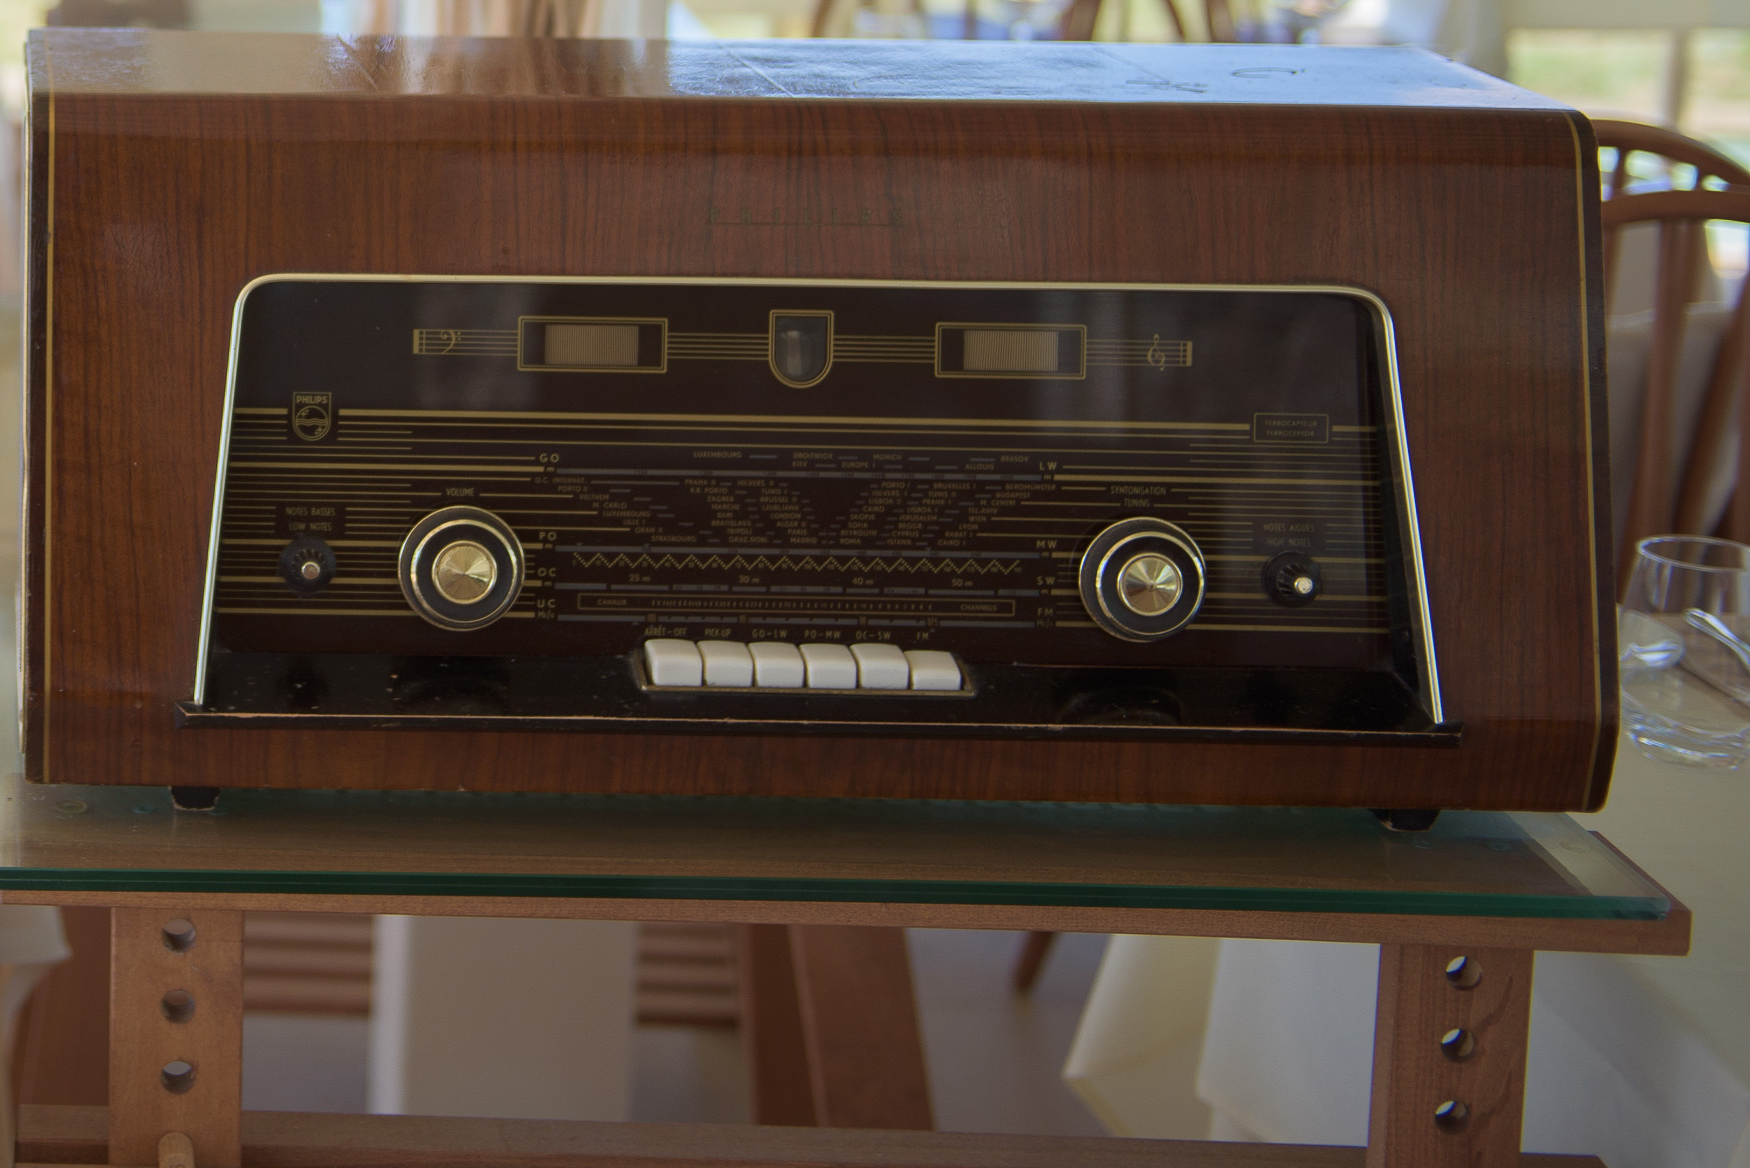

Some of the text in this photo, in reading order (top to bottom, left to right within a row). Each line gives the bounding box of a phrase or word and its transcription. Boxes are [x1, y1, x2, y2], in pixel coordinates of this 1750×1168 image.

[296, 396, 328, 404] PHILIPS
[446, 488, 474, 496] VOLUME
[1110, 486, 1166, 496] SYNTONISATION
[1124, 498, 1151, 507] TUNING
[310, 508, 336, 516] BASSES
[289, 522, 332, 530] LOW NOTES
[1263, 524, 1286, 532] NOTES
[1266, 538, 1311, 548] HIGH NOTES
[629, 574, 640, 582] 25
[738, 575, 750, 583] 30
[852, 576, 863, 584] 40
[952, 578, 963, 586] 50
[916, 632, 930, 640] FM
